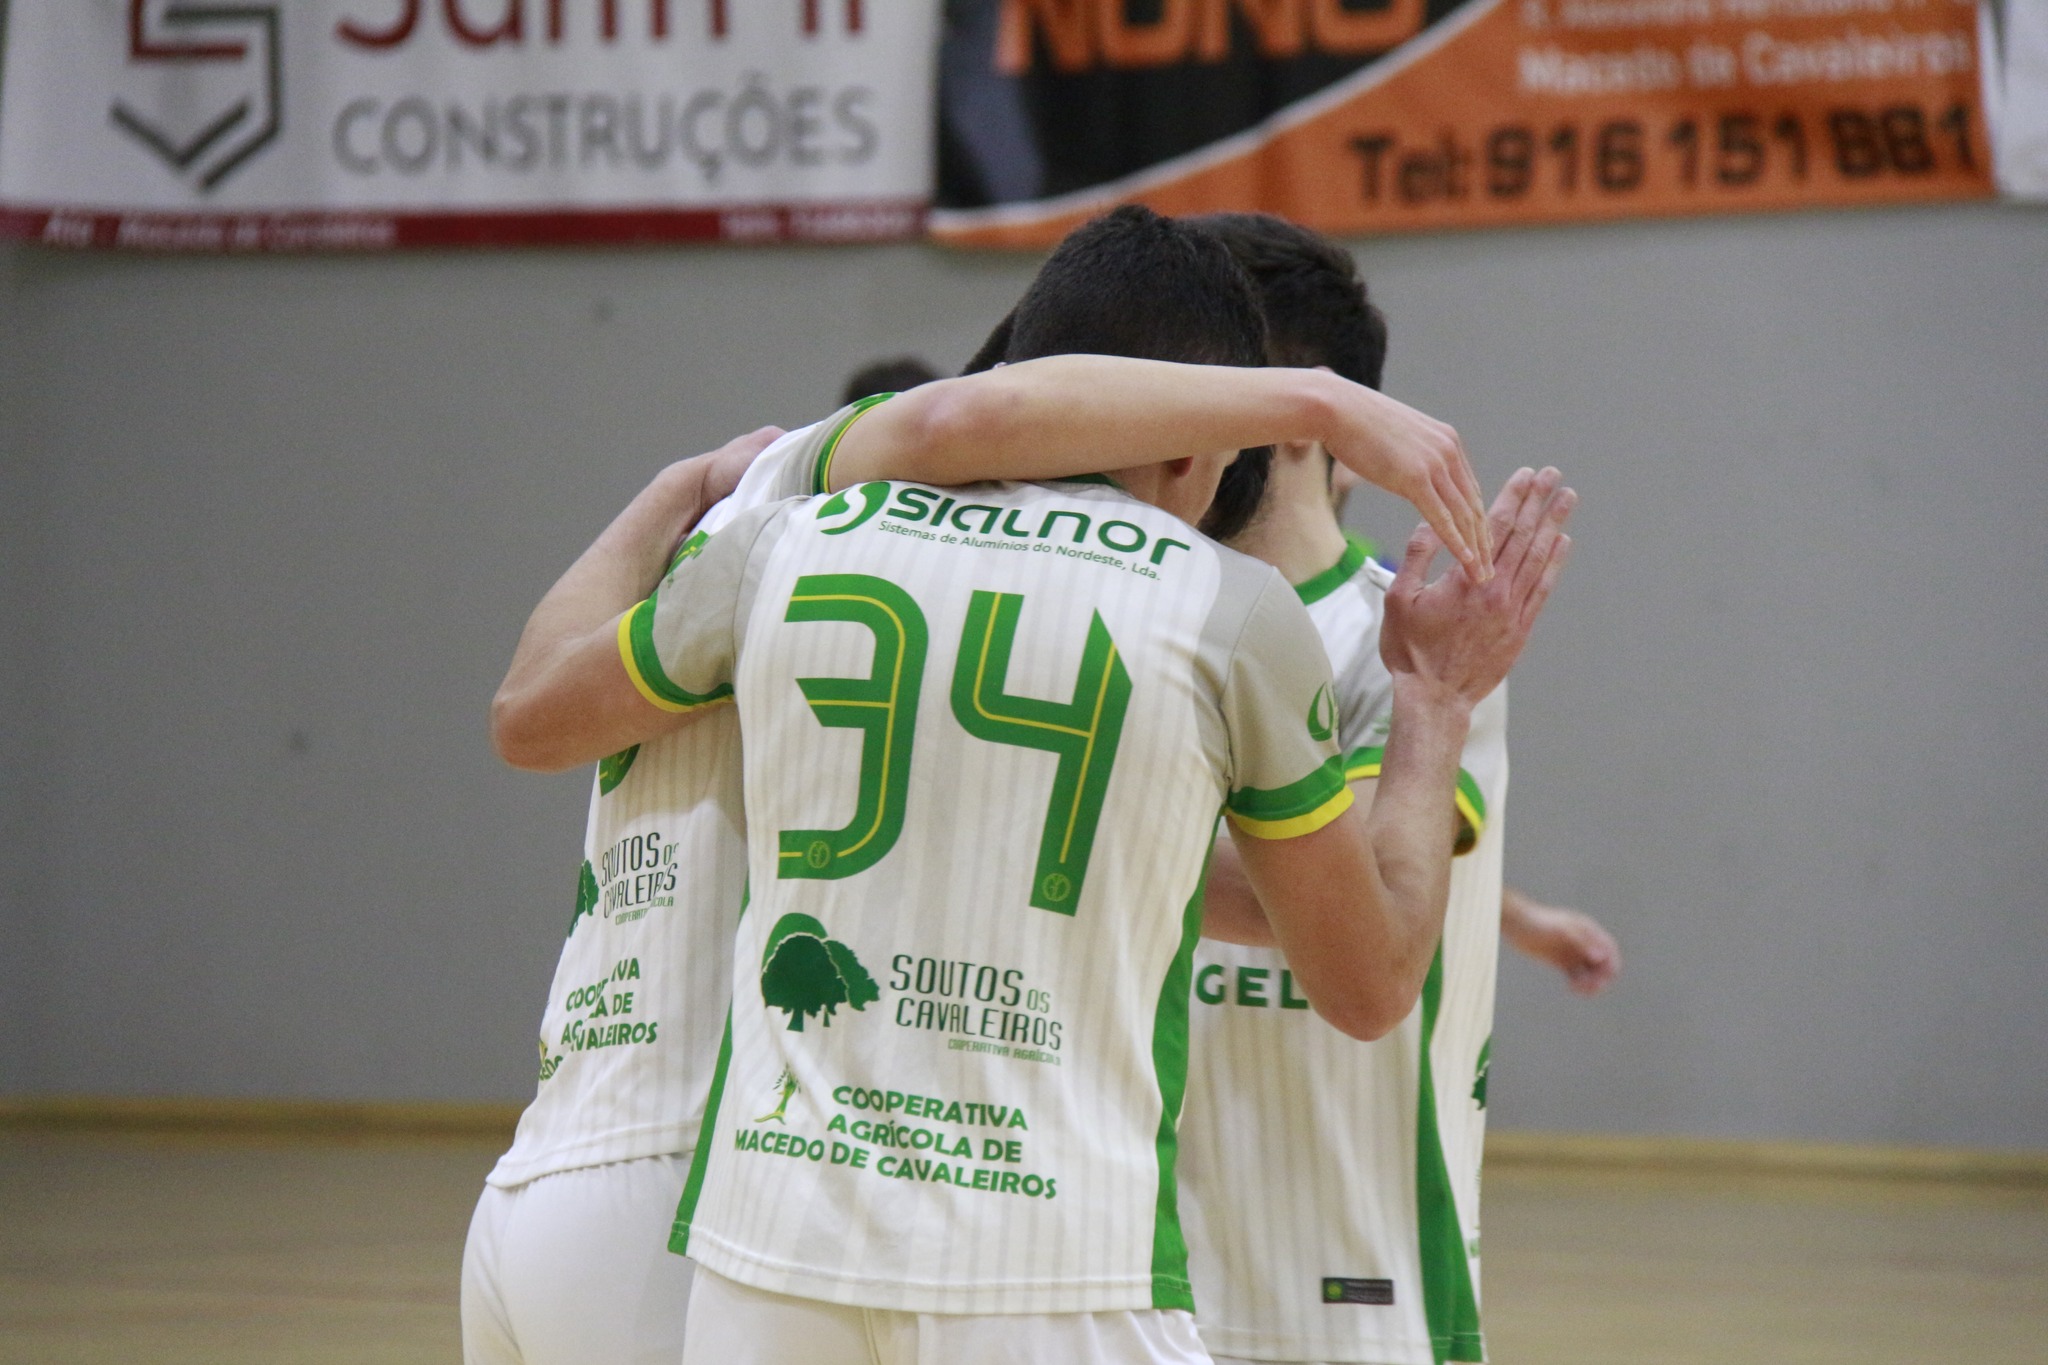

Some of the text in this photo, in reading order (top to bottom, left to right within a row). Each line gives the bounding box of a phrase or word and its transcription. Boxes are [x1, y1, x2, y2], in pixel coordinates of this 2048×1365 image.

[333, 70, 878, 181] CONSTRUÇÕES
[878, 520, 1162, 581] Sistemas de Alumínios do Nordeste, Lda.
[777, 574, 1133, 917] 34
[612, 992, 634, 1016] DE
[890, 954, 1051, 1014] SOUTOS OS
[895, 998, 1063, 1050] CAVALEIROS
[832, 1085, 1029, 1131] COOPERATIVA
[734, 1128, 1057, 1200] MACEDO DE CAVALEIROS
[827, 1114, 1023, 1163] AGRÍCOLA DE
